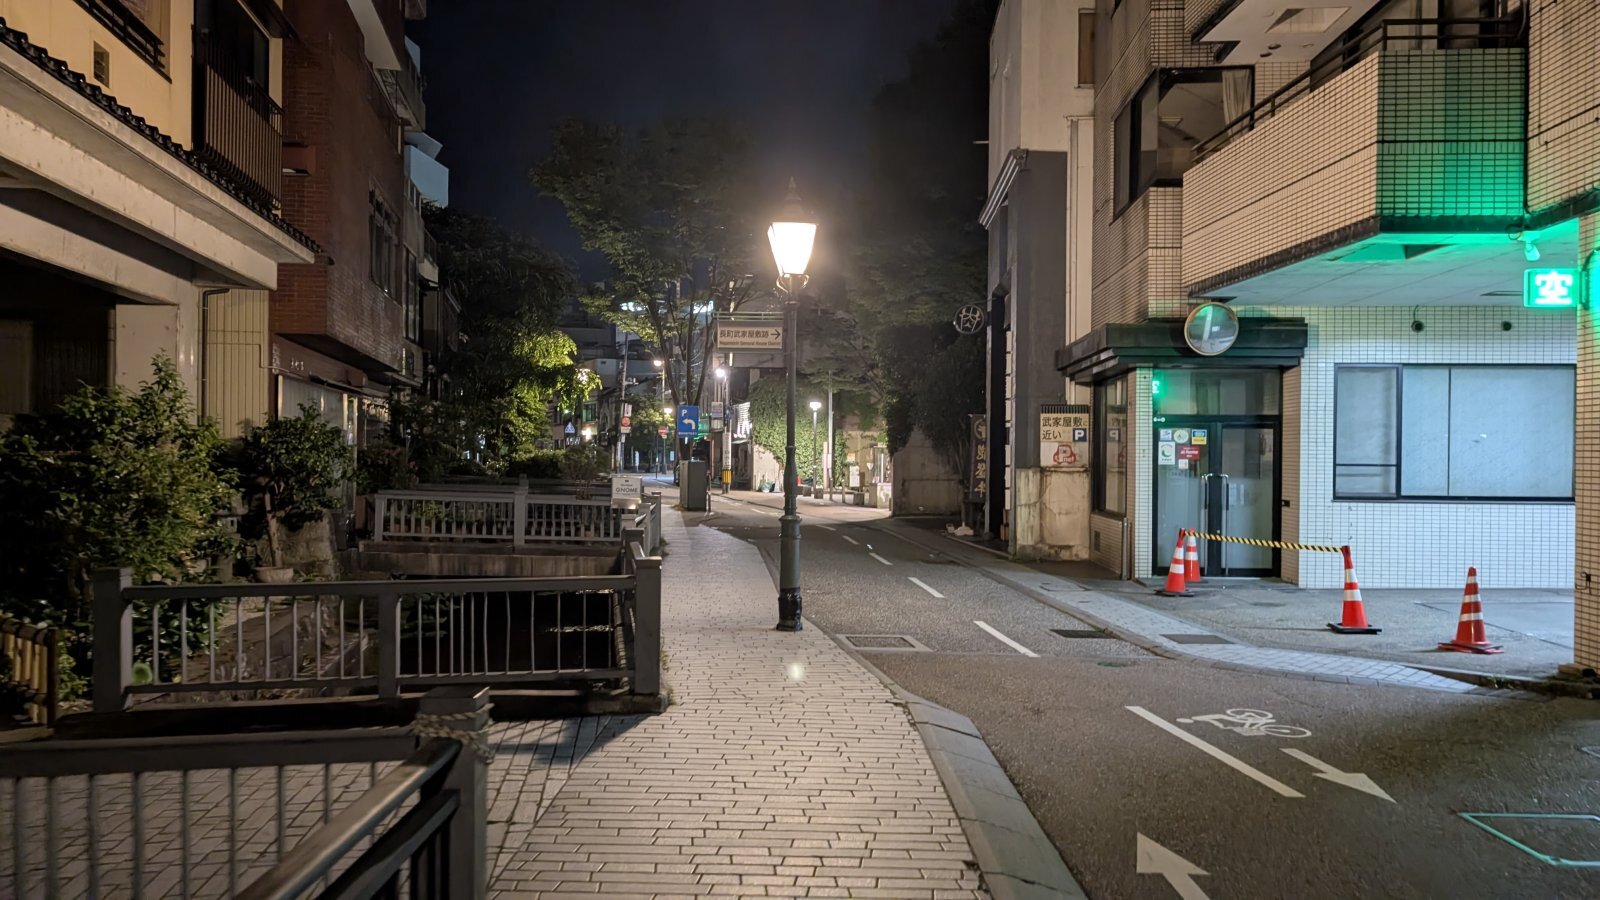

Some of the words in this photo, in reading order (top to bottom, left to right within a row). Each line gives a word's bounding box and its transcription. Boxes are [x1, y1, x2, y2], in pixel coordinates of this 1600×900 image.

[1535, 270, 1573, 304] 空
[719, 329, 770, 338] 長町武家屋敷跡
[682, 409, 688, 417] P
[1042, 429, 1062, 440] 近い
[1074, 429, 1085, 441] P
